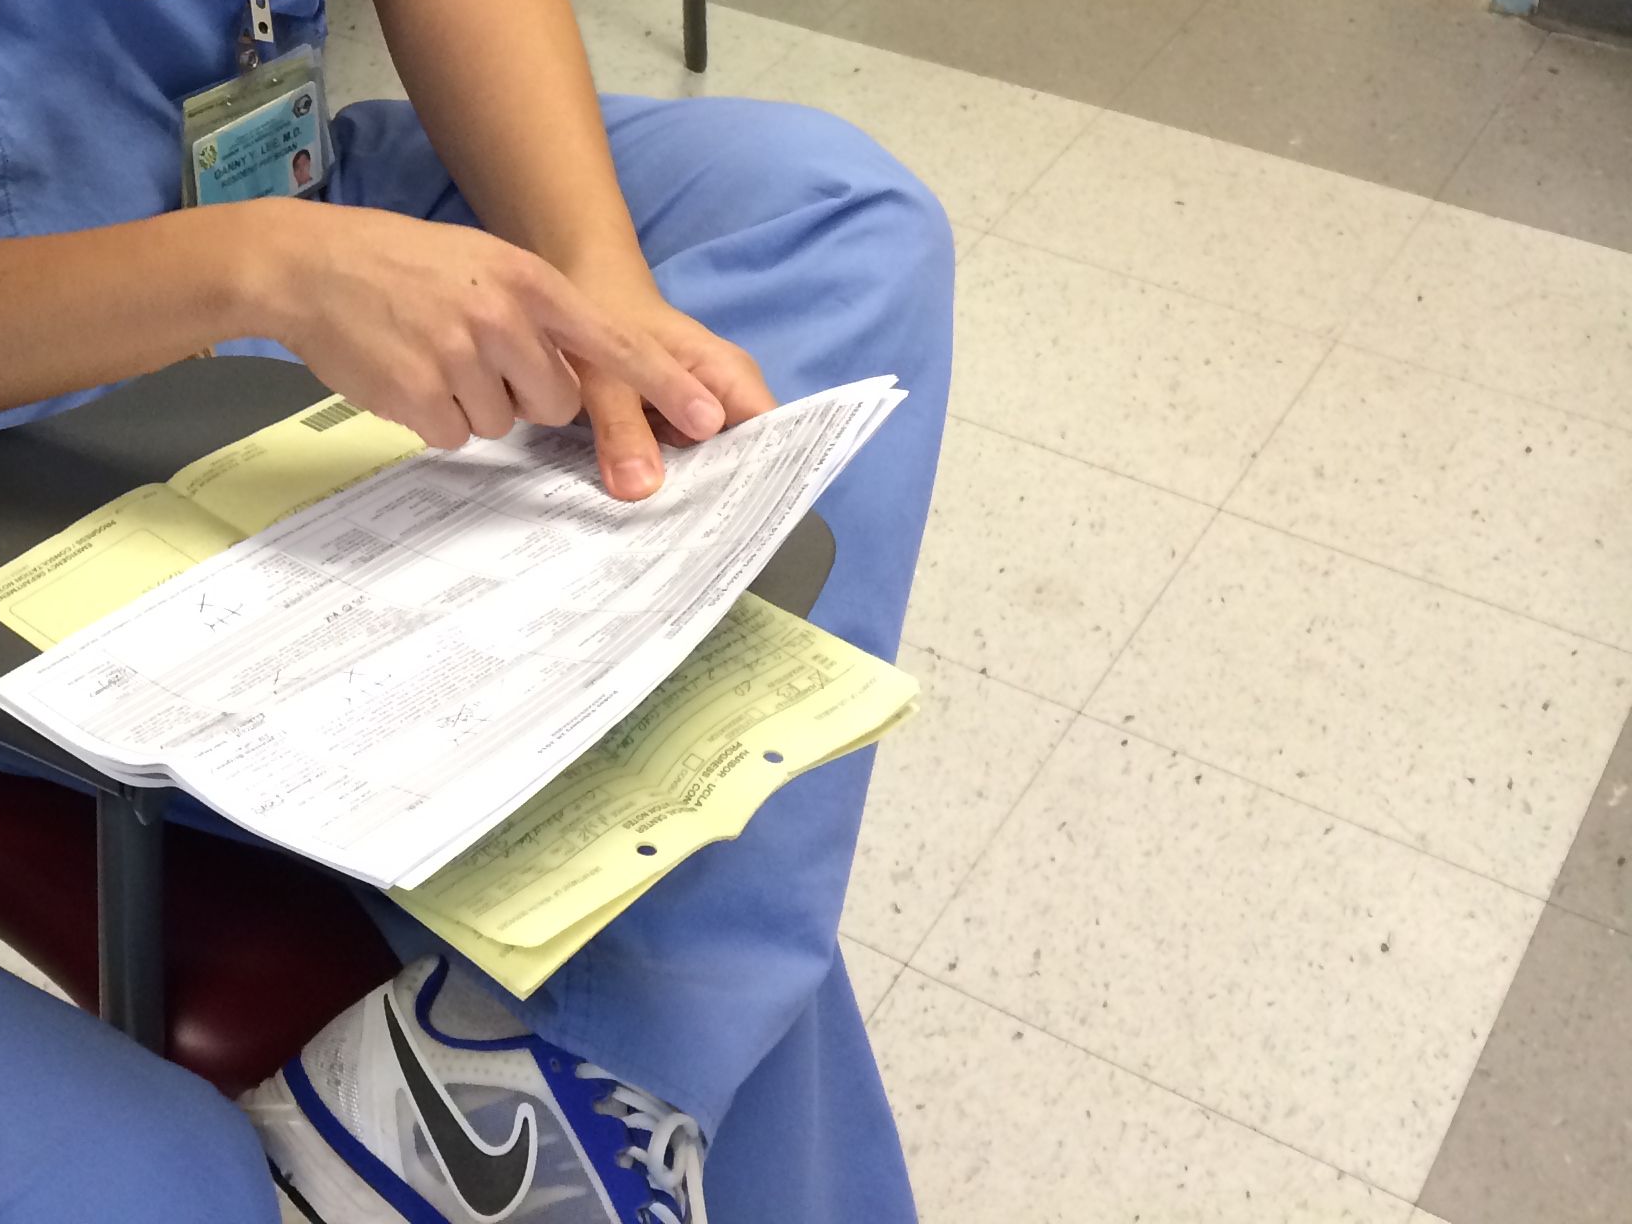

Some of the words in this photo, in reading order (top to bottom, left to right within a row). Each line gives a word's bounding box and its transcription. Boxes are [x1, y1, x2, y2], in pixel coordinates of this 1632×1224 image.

[75, 519, 116, 546] PROGRESS
[13, 545, 71, 583] CONSULTATION
[46, 541, 92, 573] EMERGENCY
[700, 739, 742, 779] PROGRESS
[716, 748, 749, 779] HARBOR
[692, 781, 716, 808] UCLA
[621, 809, 649, 830] NOTES
[635, 811, 667, 835] CENTER
